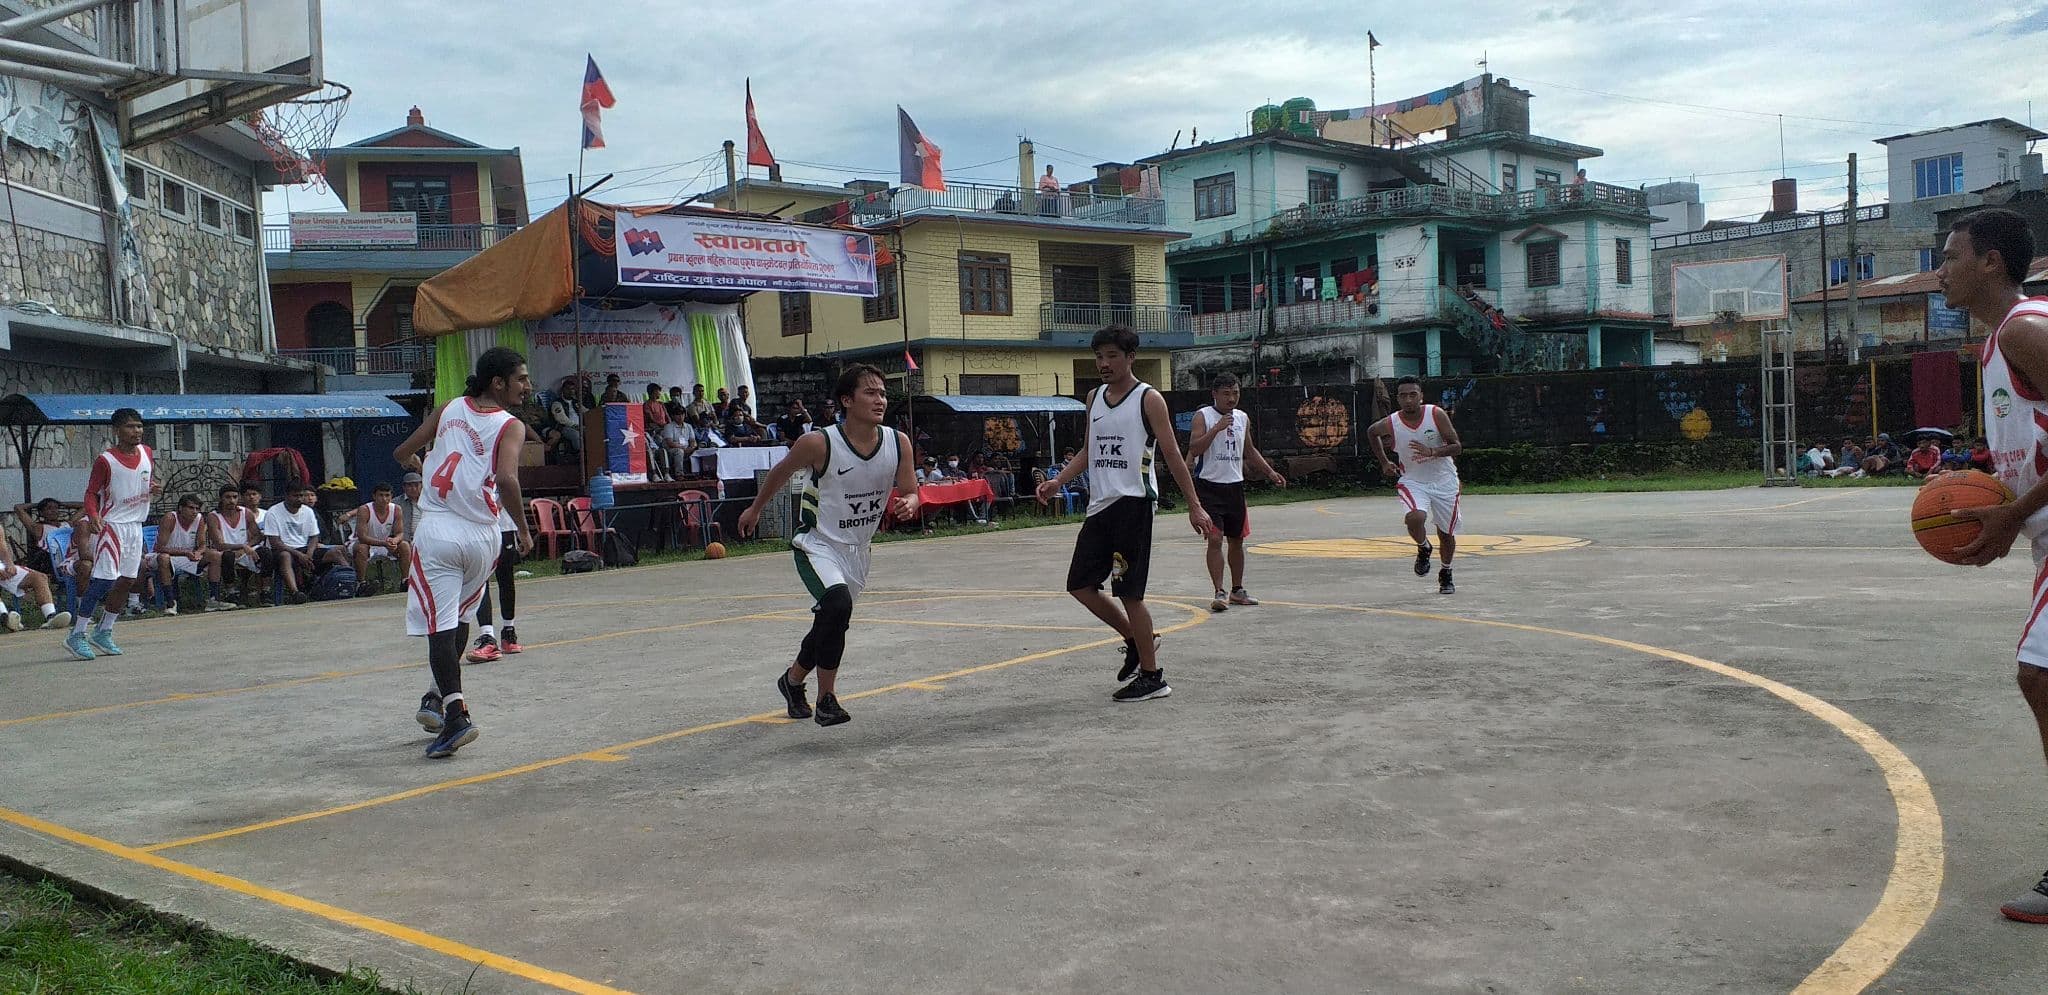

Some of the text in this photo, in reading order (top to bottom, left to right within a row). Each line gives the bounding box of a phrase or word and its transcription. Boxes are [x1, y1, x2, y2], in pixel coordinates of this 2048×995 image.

[313, 217, 338, 226] Unique
[340, 217, 382, 225] Amusement
[384, 217, 398, 225] Pvt.
[400, 217, 414, 225] Ltd.
[693, 232, 810, 258] स्वागतम्
[668, 253, 684, 264] प्रथम
[686, 254, 705, 267] खुल्ला
[707, 253, 727, 267] महिला
[727, 256, 740, 267] तथा
[653, 272, 689, 283] राष्ट्रिय
[693, 275, 713, 285] युवा
[715, 276, 734, 285] संघ
[737, 276, 767, 287] नेपाल
[372, 422, 409, 437] GENTS
[1225, 440, 1236, 451] 11
[431, 451, 463, 500] 4
[844, 491, 874, 499] Sponsored
[839, 512, 882, 529] BROTHE
